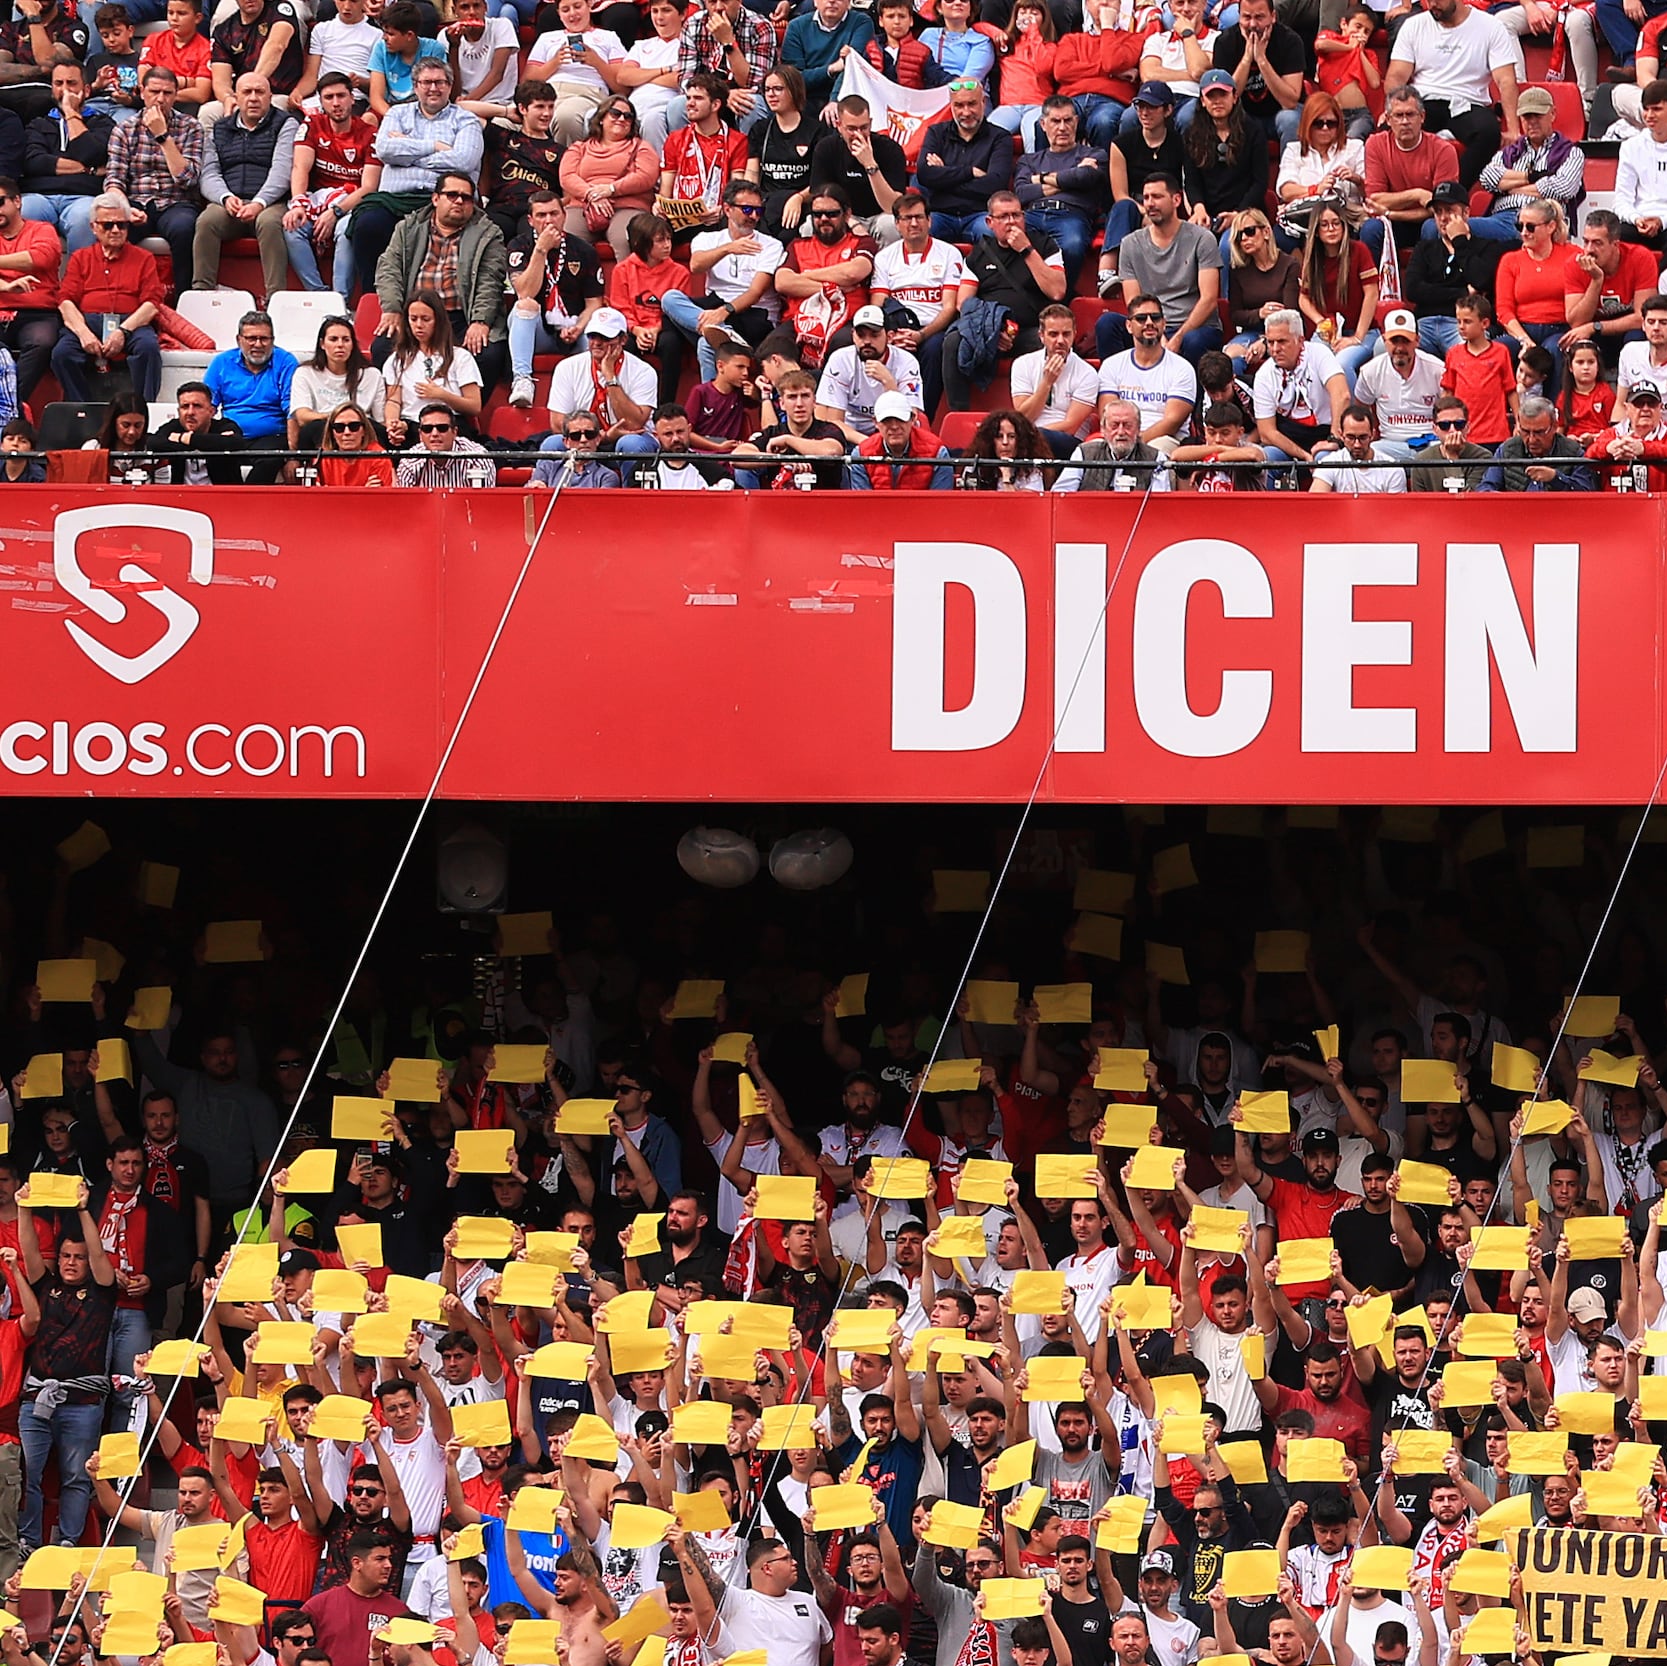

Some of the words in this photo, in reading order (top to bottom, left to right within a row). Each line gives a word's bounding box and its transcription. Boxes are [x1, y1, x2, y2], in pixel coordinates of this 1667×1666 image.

[928, 289, 941, 300] FC
[1118, 388, 1168, 402] OLLYWOOD
[892, 539, 1579, 756] DICEN
[1395, 1494, 1418, 1507] A7
